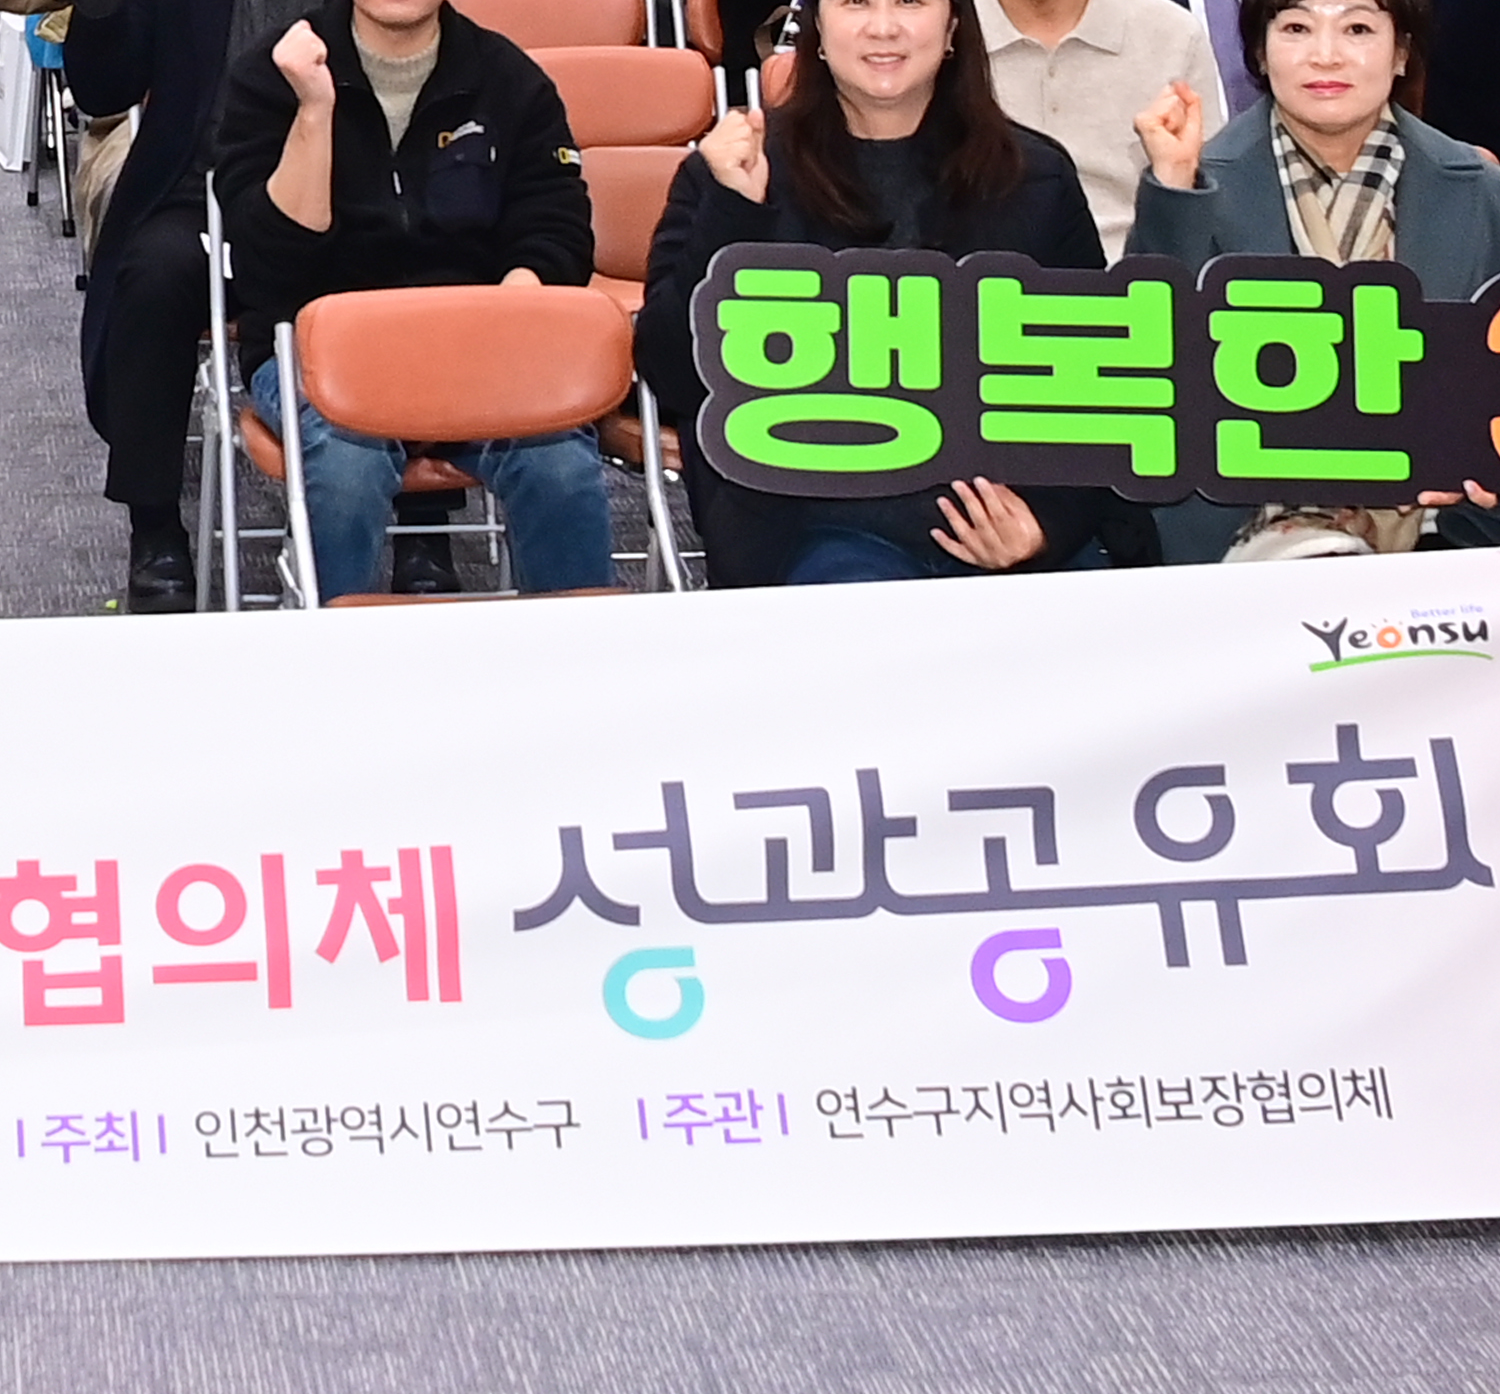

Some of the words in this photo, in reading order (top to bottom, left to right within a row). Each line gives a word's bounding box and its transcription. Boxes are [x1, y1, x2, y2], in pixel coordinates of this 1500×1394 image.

[718, 269, 1423, 480] 행복한
[1301, 617, 1489, 662] Yeonsu
[512, 722, 1496, 1040] 성과공유회
[194, 1099, 581, 1159] 인천광역시연수구
[815, 1066, 1394, 1140] 연수구지역사회보장협의체
